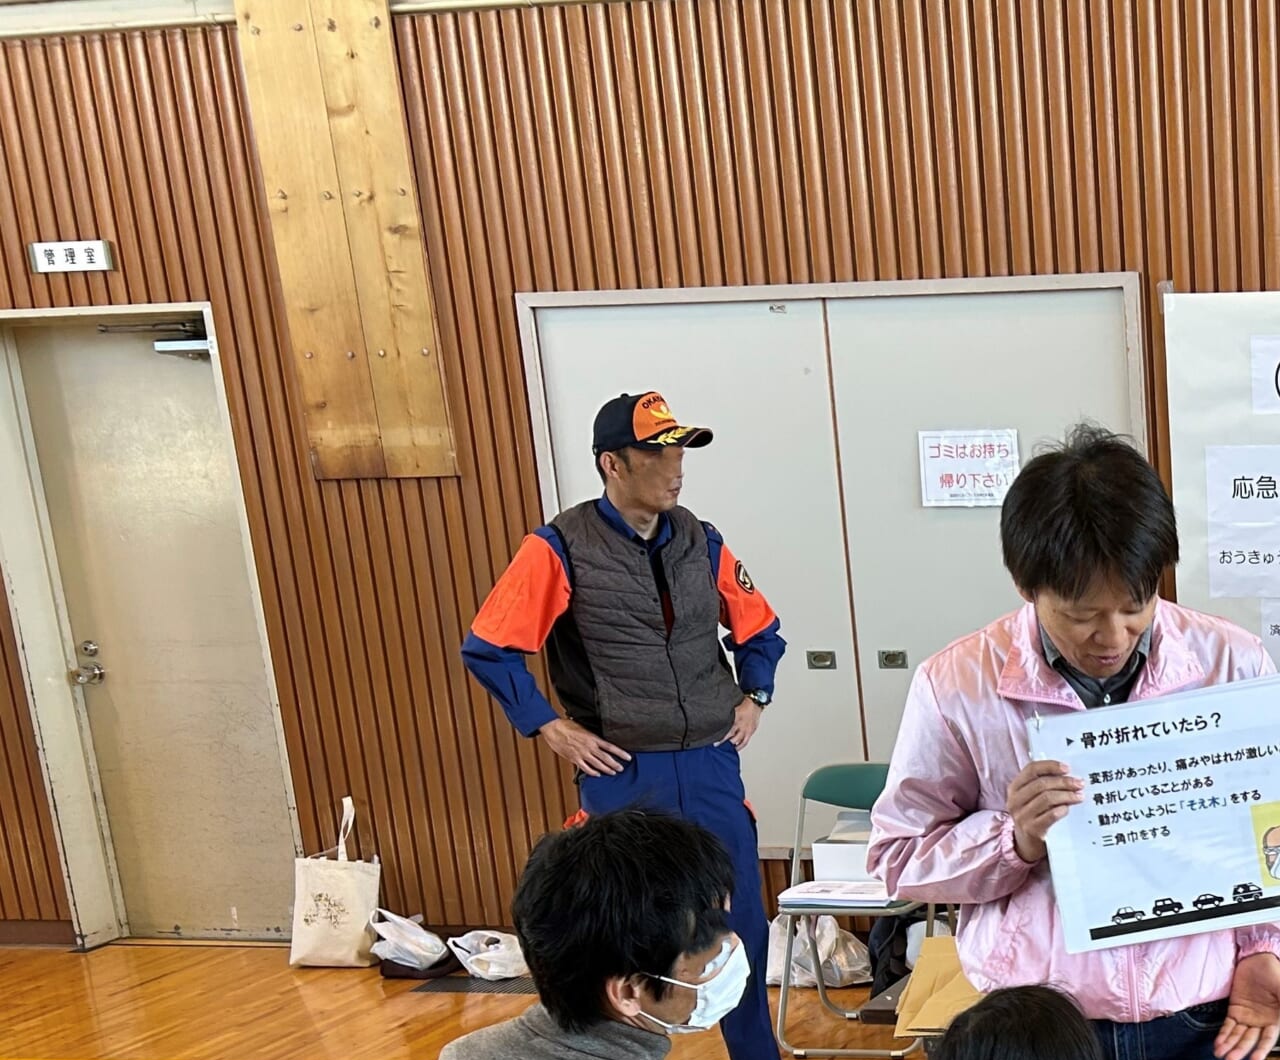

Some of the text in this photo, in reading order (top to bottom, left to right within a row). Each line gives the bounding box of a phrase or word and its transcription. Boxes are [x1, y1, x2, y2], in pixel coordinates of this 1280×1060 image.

[43, 246, 97, 266] 管理室
[928, 443, 1010, 459] ゴミはお持ち
[939, 472, 1010, 489] 帰り下さい
[1092, 775, 1215, 806] 骨折していることがある
[1101, 825, 1171, 848] 三角巾をする
